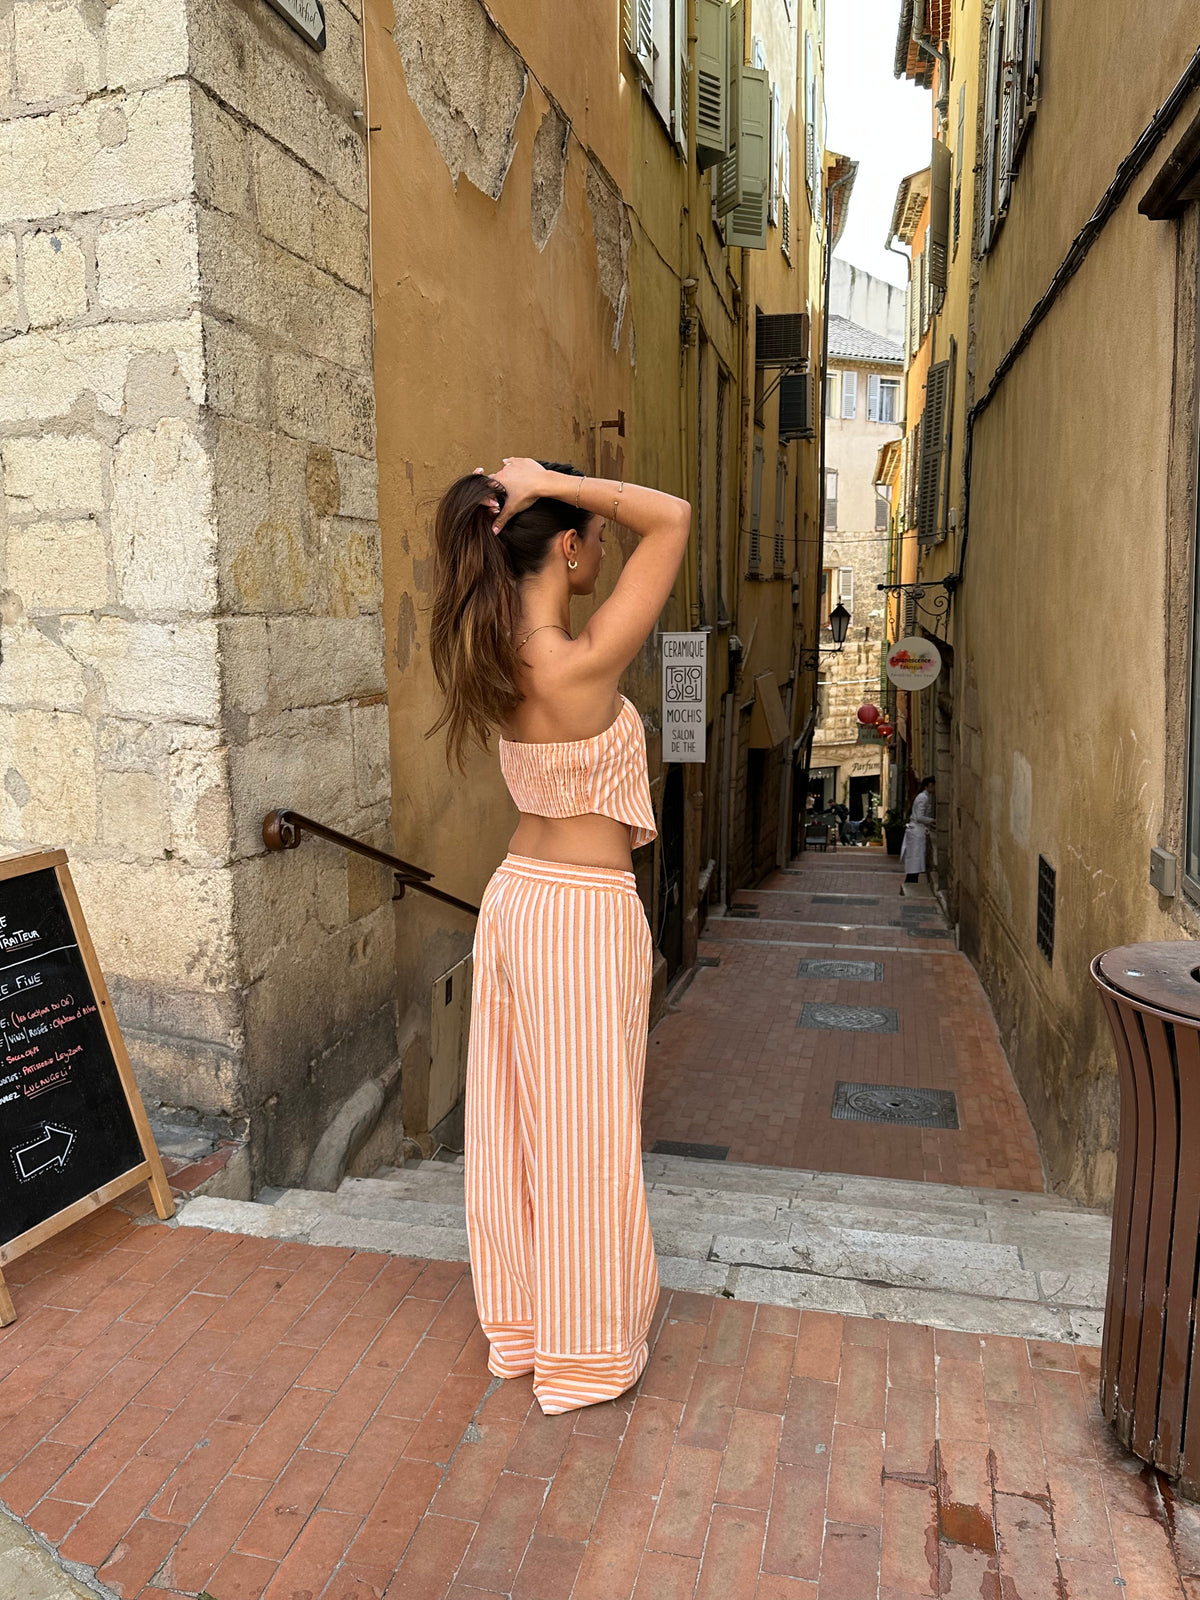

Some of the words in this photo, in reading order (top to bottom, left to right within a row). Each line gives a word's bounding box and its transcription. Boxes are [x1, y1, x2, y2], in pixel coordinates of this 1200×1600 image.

[663, 640, 705, 659] CERAMIQUE
[666, 709, 702, 723] MOCHIS
[671, 729, 695, 740] SALON
[671, 742, 680, 752] DE
[682, 742, 696, 752] THE
